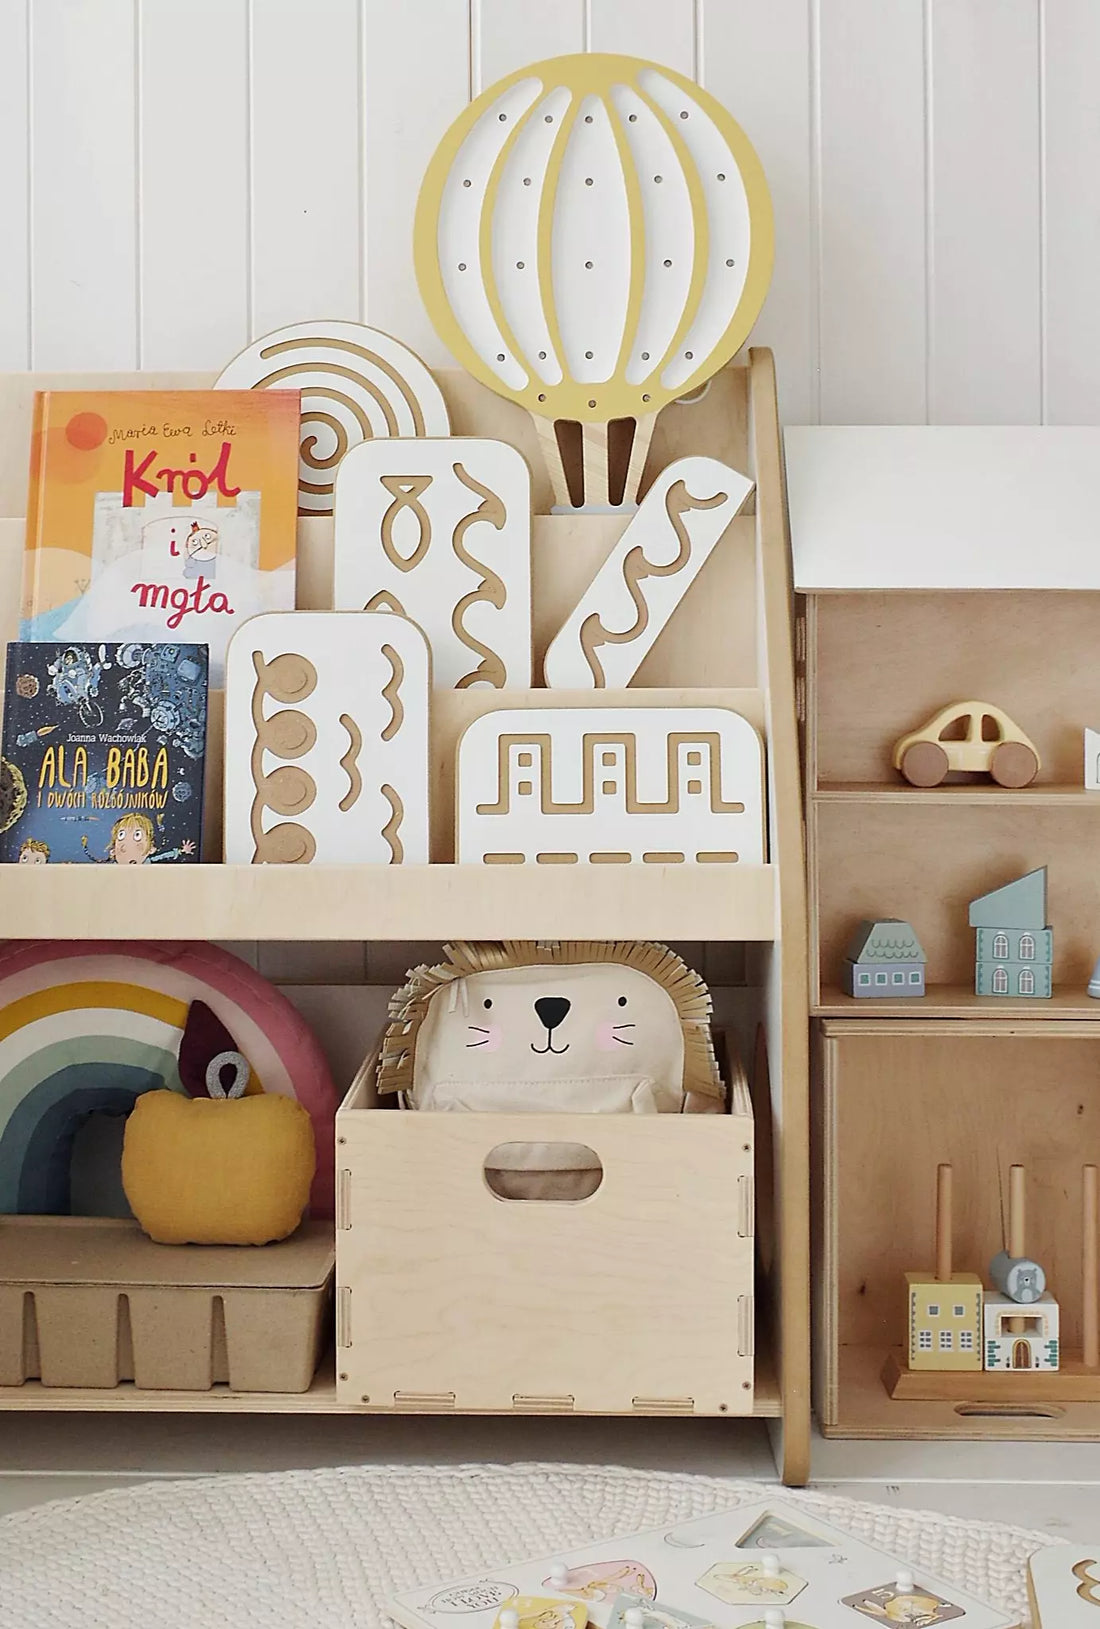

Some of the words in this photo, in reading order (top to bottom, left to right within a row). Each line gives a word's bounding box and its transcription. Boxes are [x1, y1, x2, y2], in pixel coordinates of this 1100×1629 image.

[108, 423, 158, 444] Maria
[162, 423, 192, 438] Ewa
[122, 441, 241, 508] Król
[169, 528, 180, 557] i
[131, 575, 235, 629] mgła
[66, 733, 96, 743] Joanna
[99, 733, 147, 743] Wachowiak
[38, 744, 88, 788] ALA
[106, 746, 168, 789] BABA
[37, 790, 43, 808] I
[47, 787, 86, 809] DWÓCH
[91, 788, 169, 809] ROZBÓJNIKÓW
